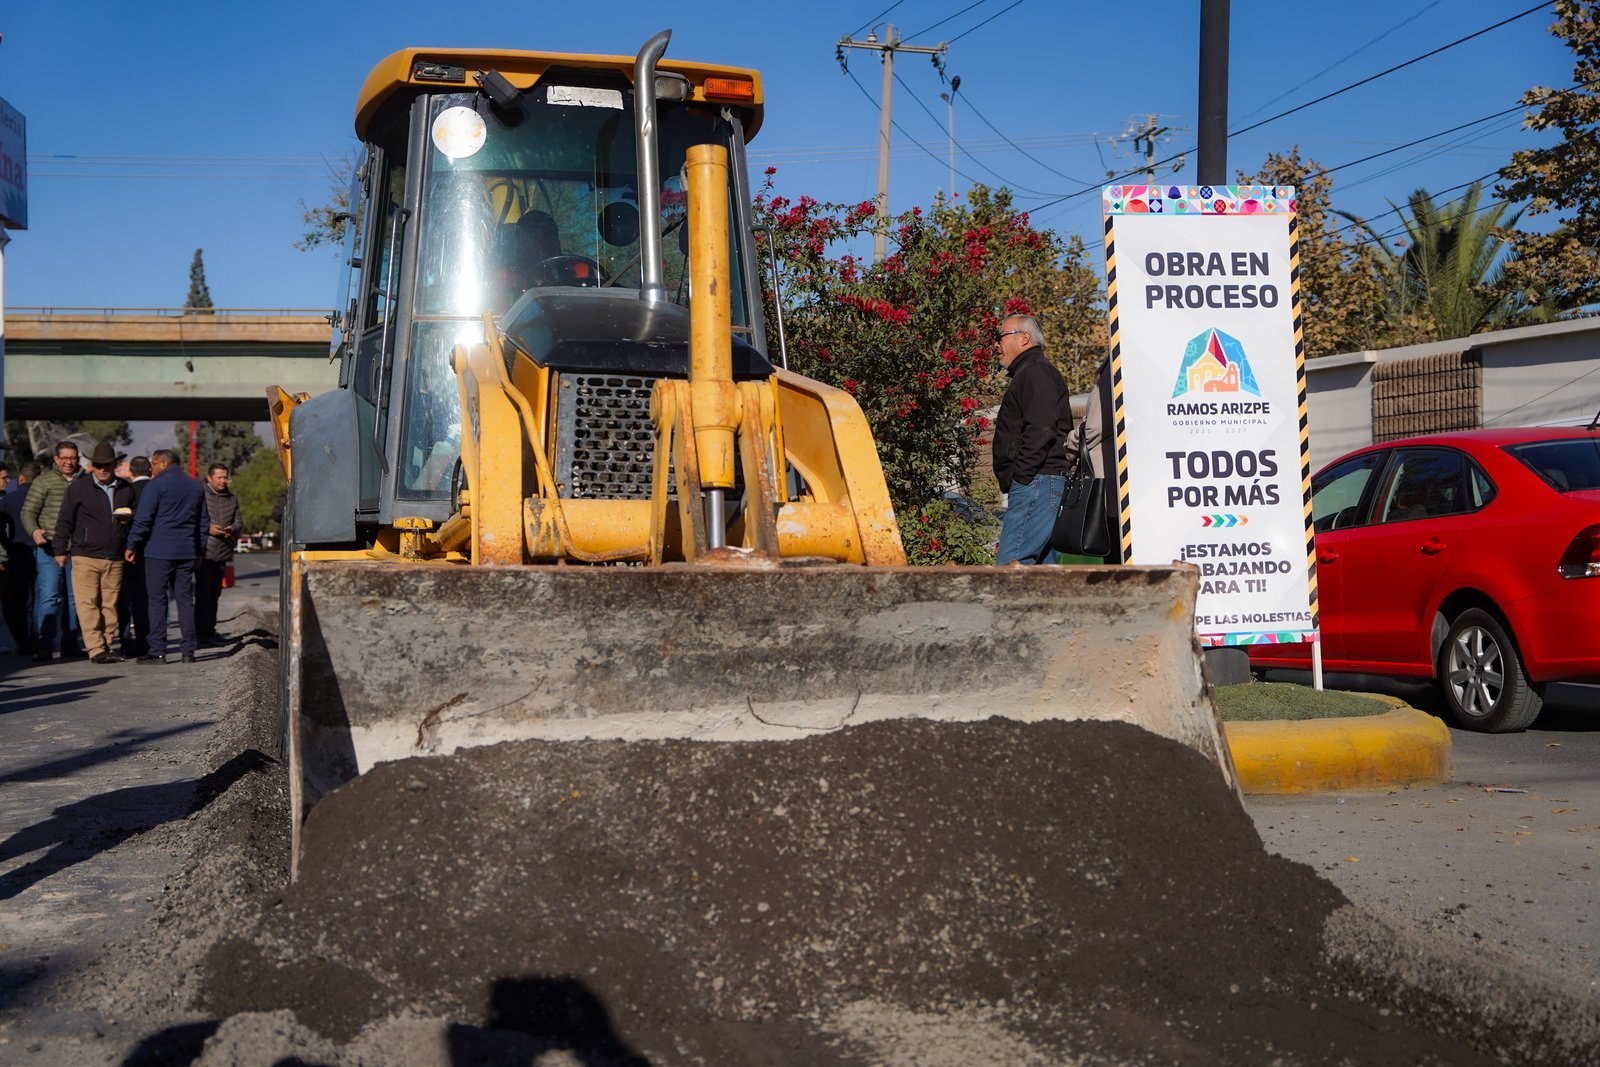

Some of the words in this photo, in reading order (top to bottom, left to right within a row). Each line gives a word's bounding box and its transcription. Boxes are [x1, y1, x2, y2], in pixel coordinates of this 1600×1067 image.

[1145, 252, 1226, 277] OBRA
[1231, 252, 1270, 276] EN
[1145, 284, 1279, 310] PROCESO
[1167, 403, 1218, 416] RAMOS
[1221, 402, 1270, 415] ARIZPE
[1165, 449, 1278, 480] TODOS
[1168, 485, 1220, 508] POR
[1224, 479, 1280, 507] MÁS
[1180, 542, 1272, 561] ¡ESTAMOS
[1198, 560, 1292, 577] BAJANDO
[1244, 579, 1267, 593] TI!
[1215, 614, 1239, 625] LAS
[1242, 611, 1312, 624] MOLESTIAS
